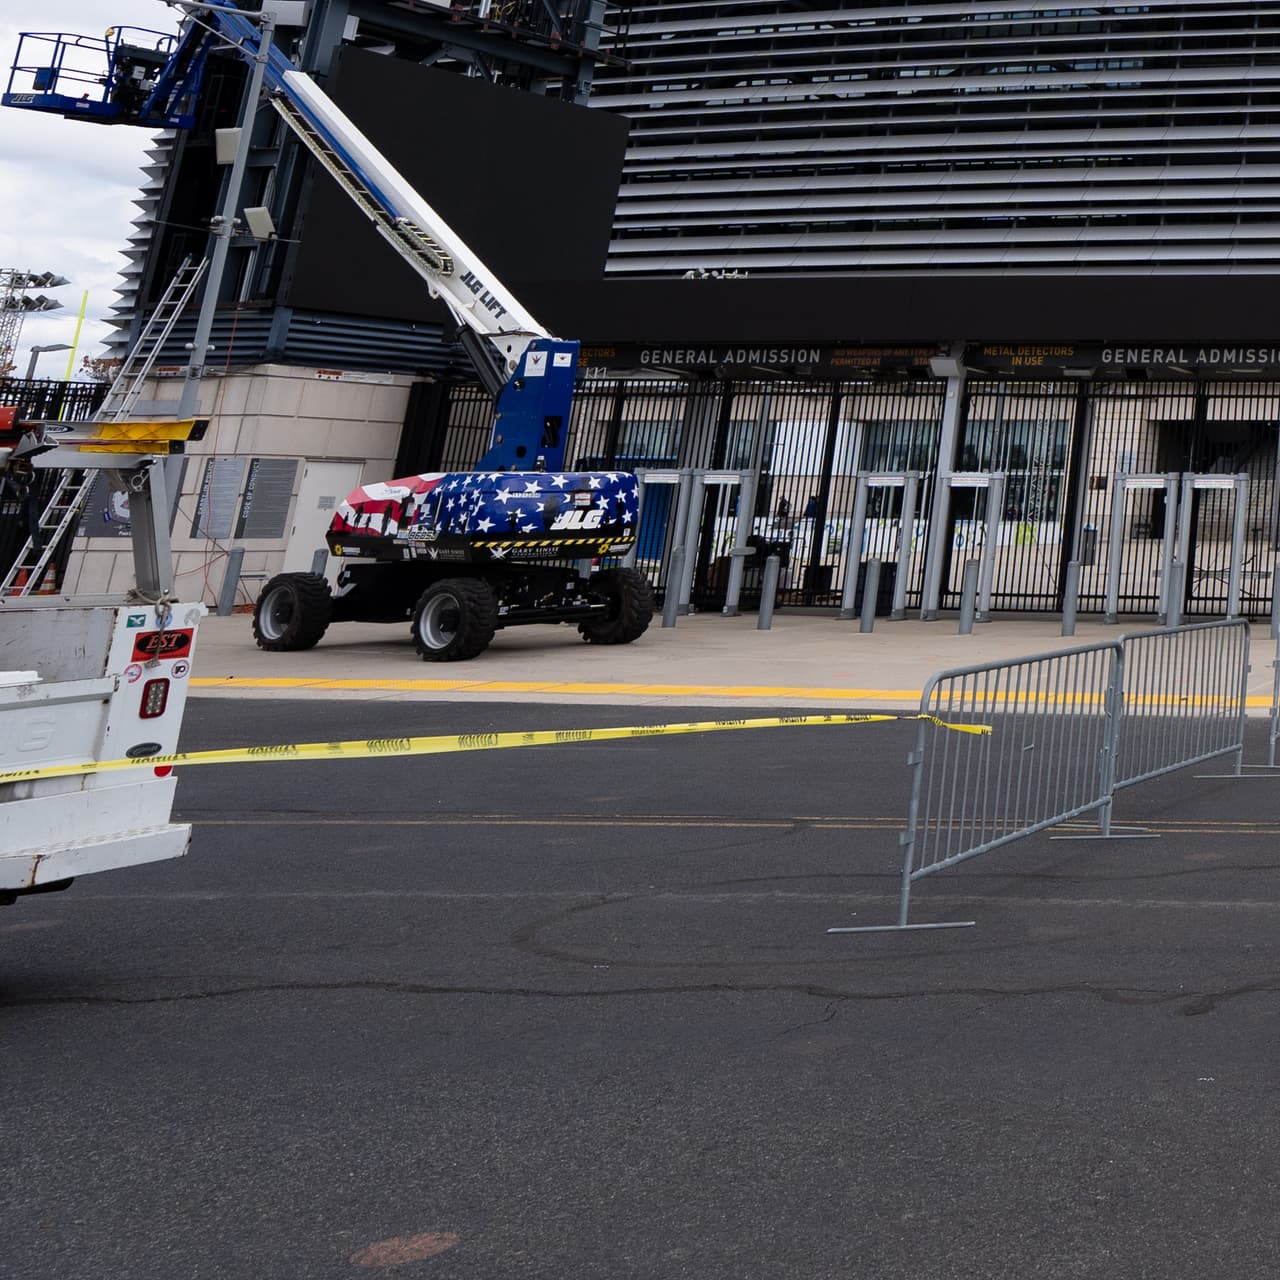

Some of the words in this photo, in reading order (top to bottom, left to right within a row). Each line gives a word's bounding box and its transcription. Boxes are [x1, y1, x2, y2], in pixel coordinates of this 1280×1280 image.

[460, 271, 483, 295] JLG
[479, 290, 507, 319] LIFT
[582, 349, 616, 357] ECTORS
[640, 349, 717, 364] GENERAL
[724, 349, 820, 364] ADMISSION
[984, 347, 1015, 356] METAL
[1018, 347, 1074, 356] DETECTORS
[1102, 348, 1188, 363] GENERAL
[1011, 356, 1022, 366] IN
[1025, 356, 1044, 366] USE
[551, 509, 605, 530] JLG
[146, 633, 182, 649] EST
